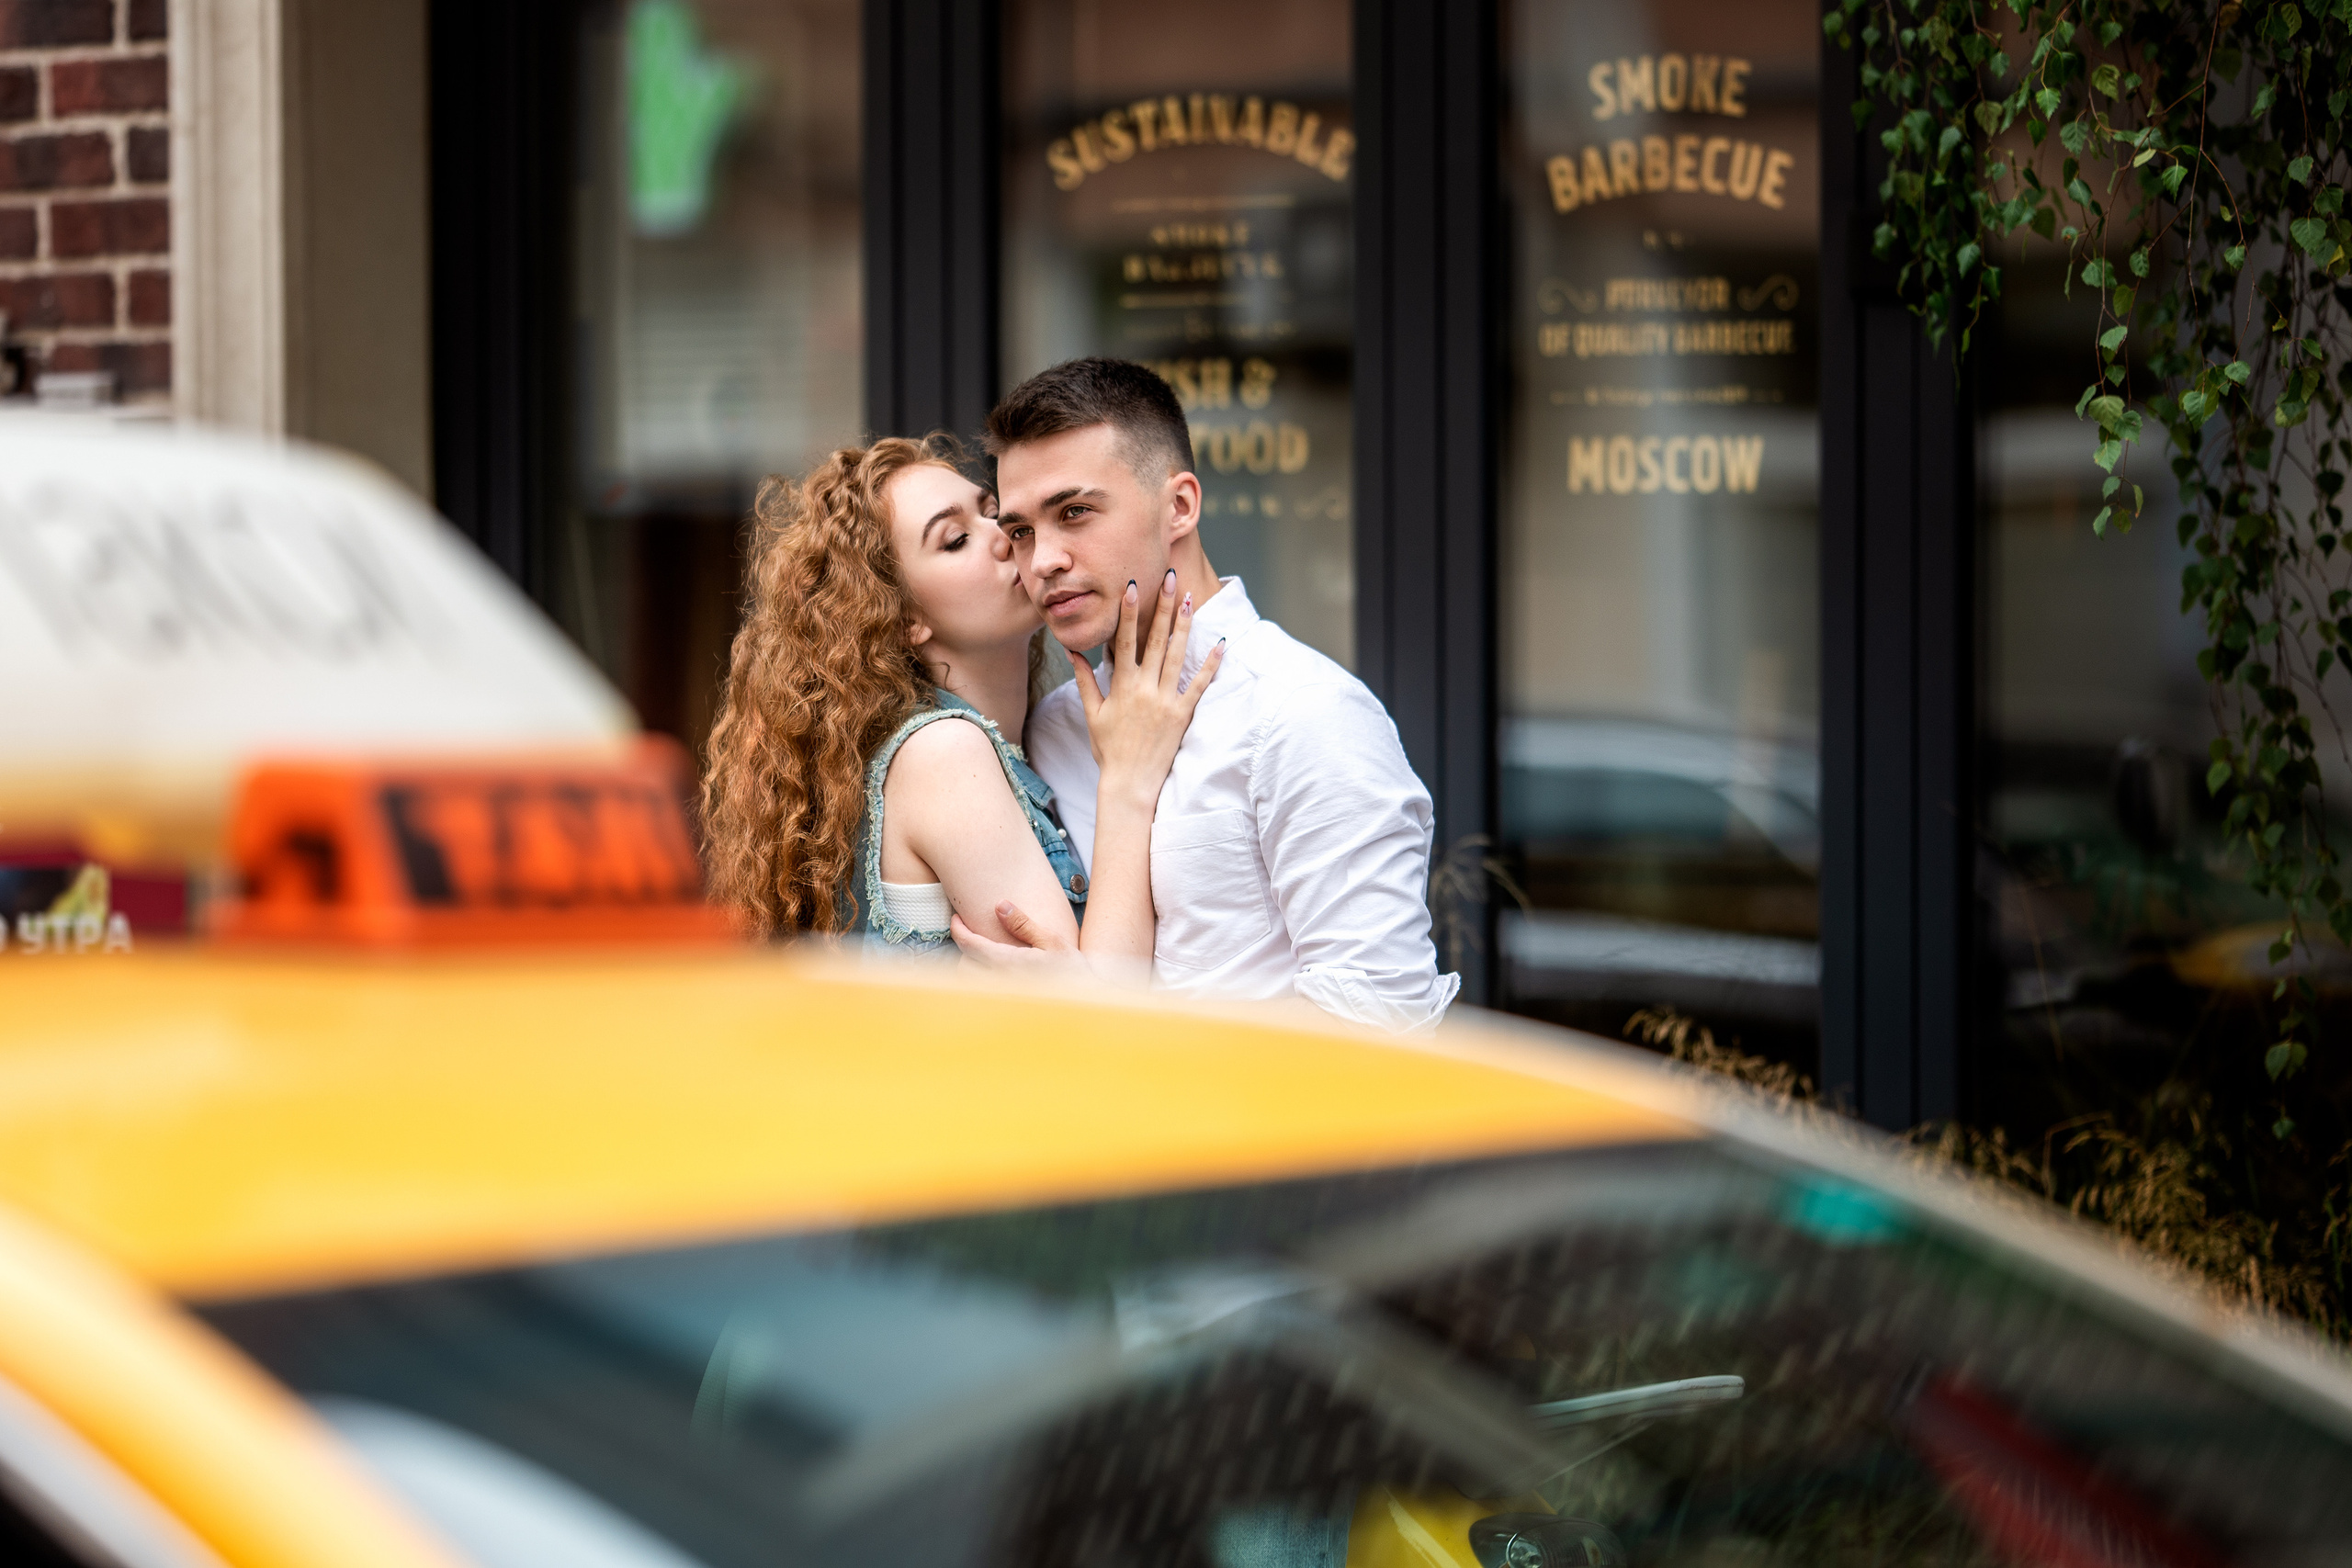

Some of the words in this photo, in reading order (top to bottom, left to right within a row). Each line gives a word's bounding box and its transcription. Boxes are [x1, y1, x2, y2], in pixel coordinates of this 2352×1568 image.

[1588, 52, 1752, 121] SMOKE
[1046, 94, 1356, 191] SUSTAINABLE
[1546, 133, 1793, 214] BARBECUE
[1566, 434, 1765, 495] MOSCOW
